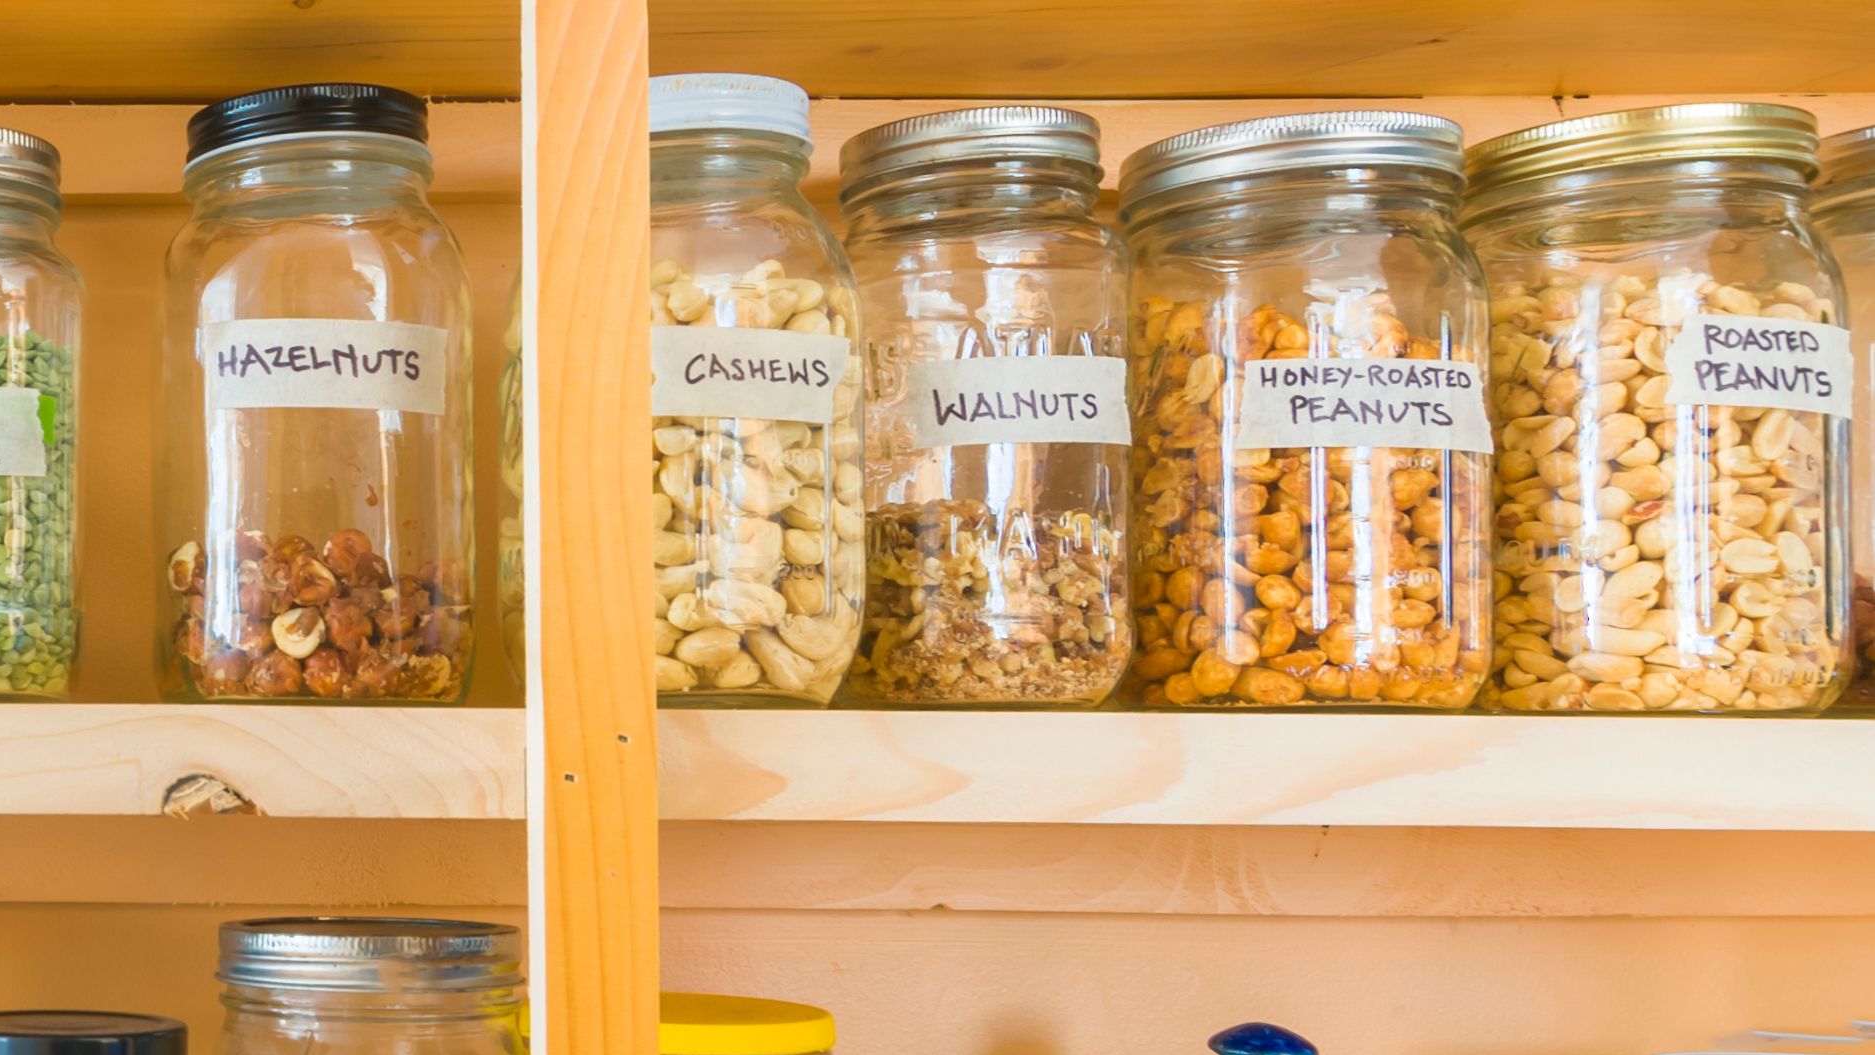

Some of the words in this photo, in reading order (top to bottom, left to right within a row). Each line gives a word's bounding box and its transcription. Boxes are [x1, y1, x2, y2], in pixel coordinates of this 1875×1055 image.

[1704, 324, 1819, 354] ROASTED
[219, 344, 420, 381] HAZELNUTS
[685, 354, 829, 387] CASHEWS
[1261, 365, 1471, 388] HONEY-ROASTED
[1695, 360, 1831, 397] PEANUTS
[932, 389, 1097, 426] WALNUTS
[1290, 395, 1453, 426] PEANUTS
